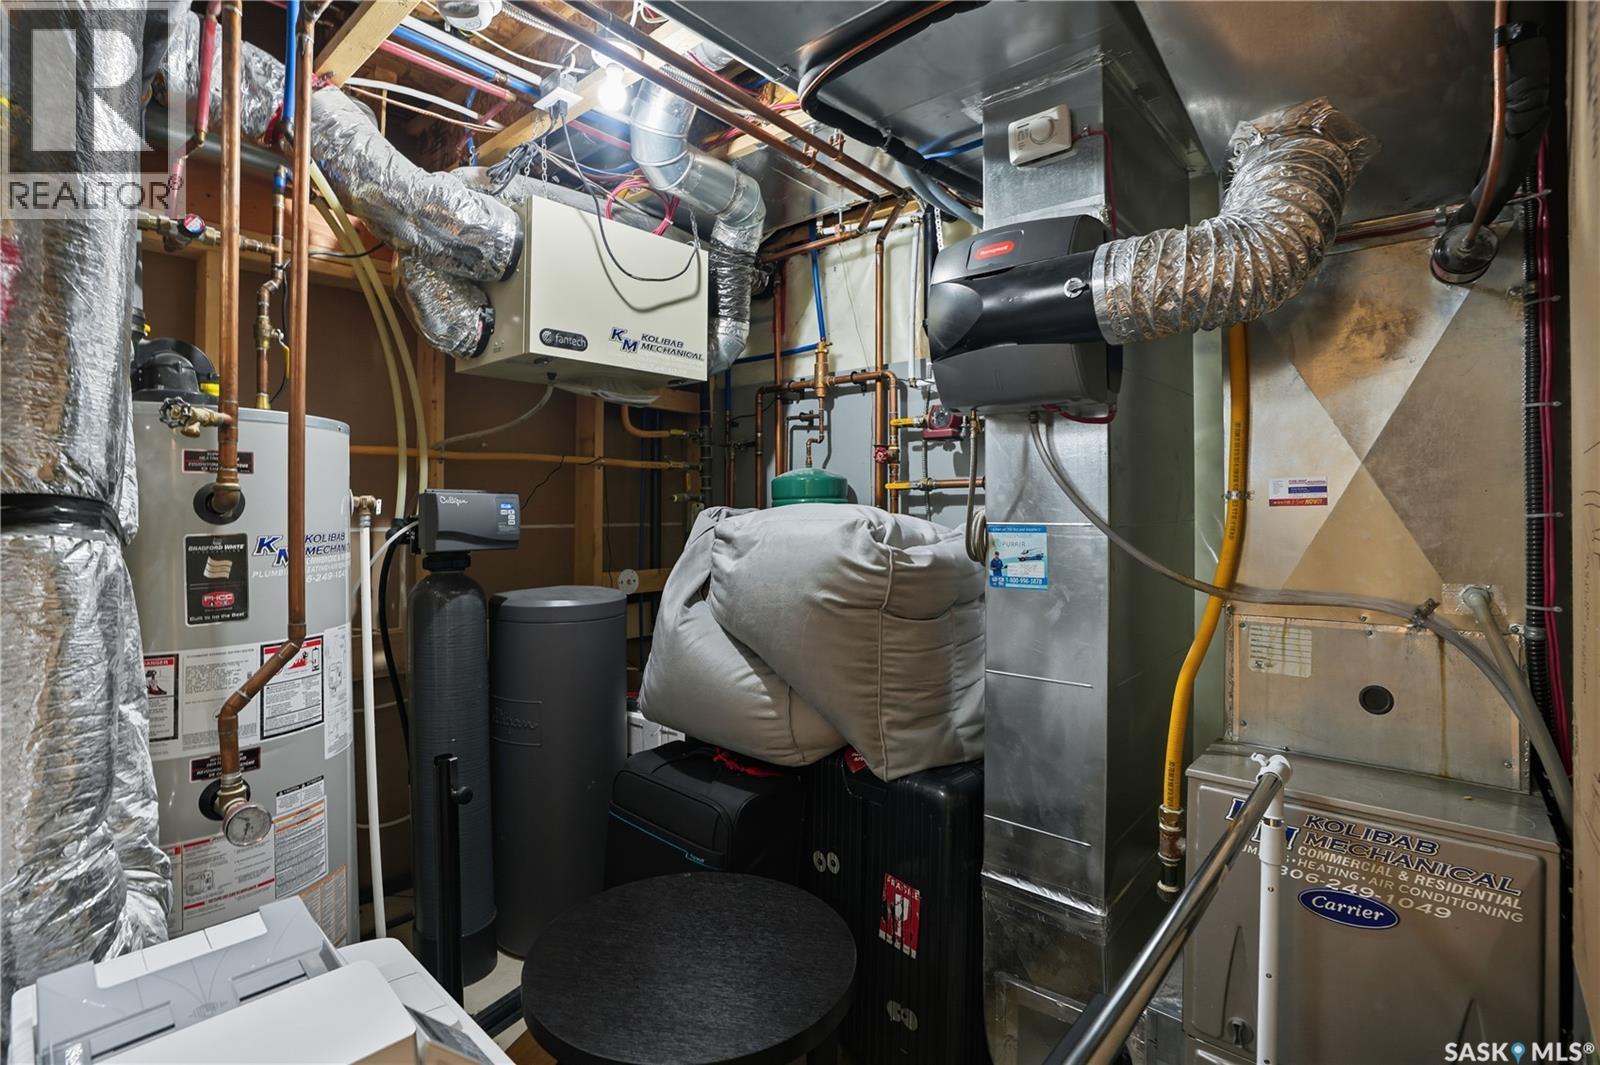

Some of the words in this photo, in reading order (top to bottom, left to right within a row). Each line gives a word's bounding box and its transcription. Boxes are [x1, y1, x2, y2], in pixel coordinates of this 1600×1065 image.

[555, 331, 587, 348] fantech
[640, 343, 704, 361] MECHANICAL
[641, 333, 684, 348] KOLIBAB
[439, 496, 468, 507] Culligan
[1305, 814, 1440, 857] KOLIBAB
[1304, 832, 1523, 896] MECHANICAL
[1298, 846, 1394, 878] COMMERCIAL
[1398, 870, 1409, 881] &
[1414, 874, 1523, 910] RESIDENTIAL
[1311, 895, 1385, 921] Carrier
[1368, 877, 1394, 890] AIR
[1398, 884, 1524, 923] CONDITIONING
